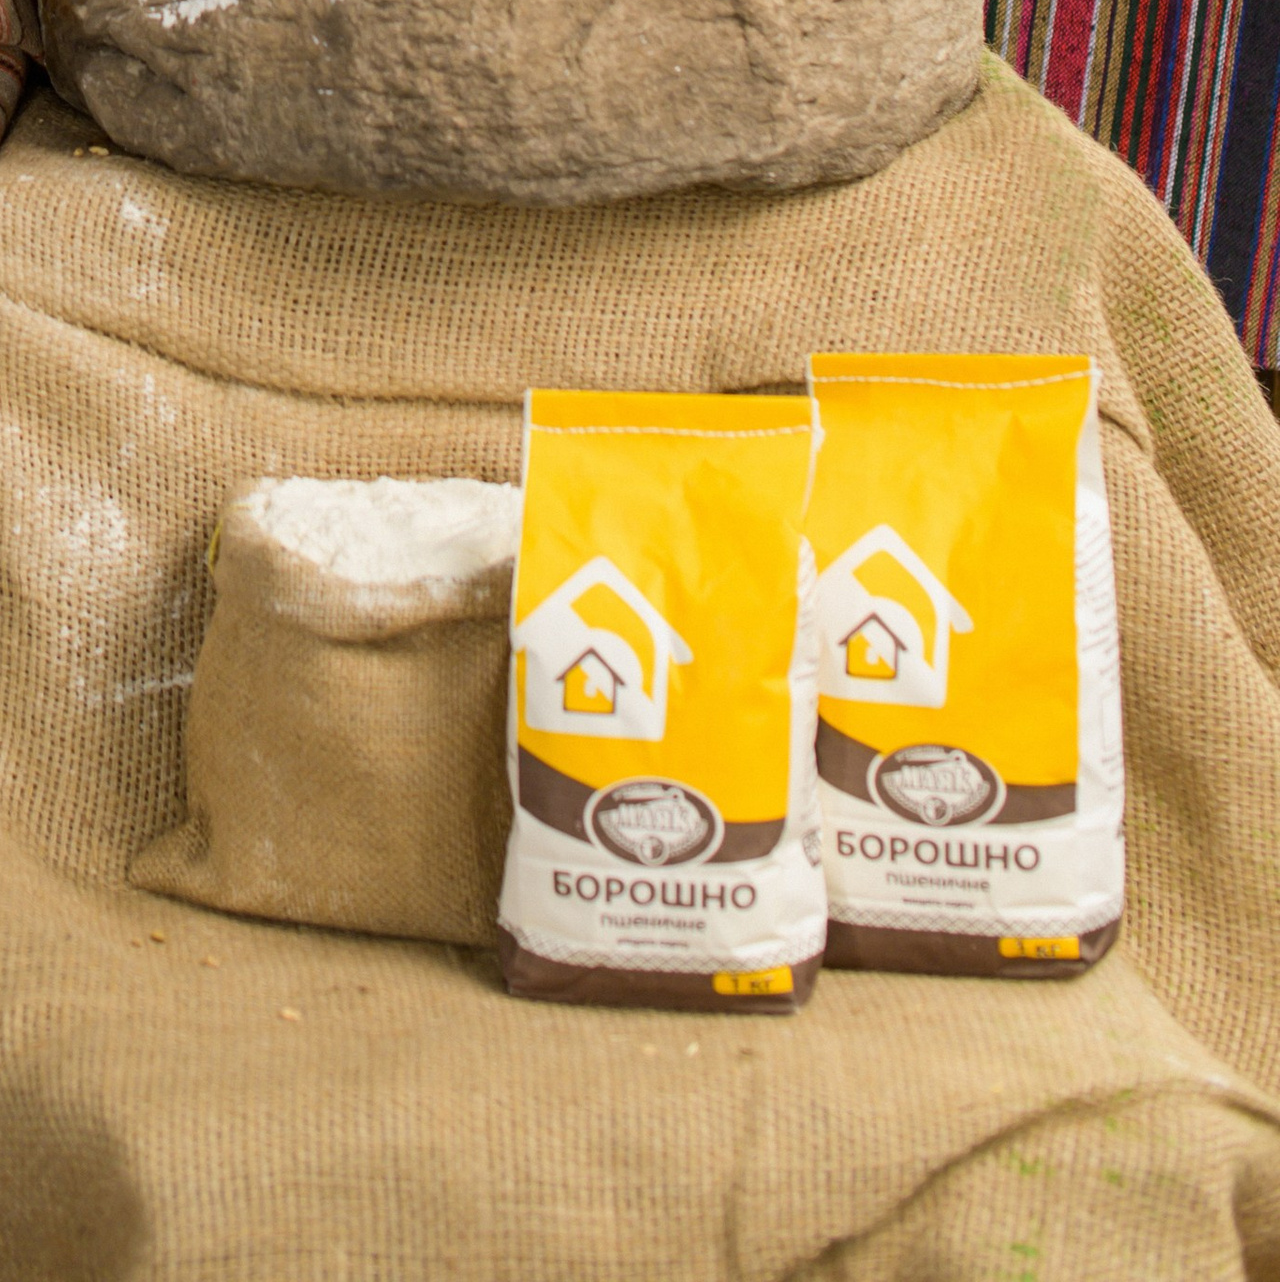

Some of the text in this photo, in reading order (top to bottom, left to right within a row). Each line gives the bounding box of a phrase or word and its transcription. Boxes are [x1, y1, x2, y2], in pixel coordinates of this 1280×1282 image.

[837, 831, 1041, 871] БОРОШНО
[553, 869, 757, 910] БОРОШНО
[886, 872, 991, 892] пшеничне
[600, 913, 707, 932] пшеничне
